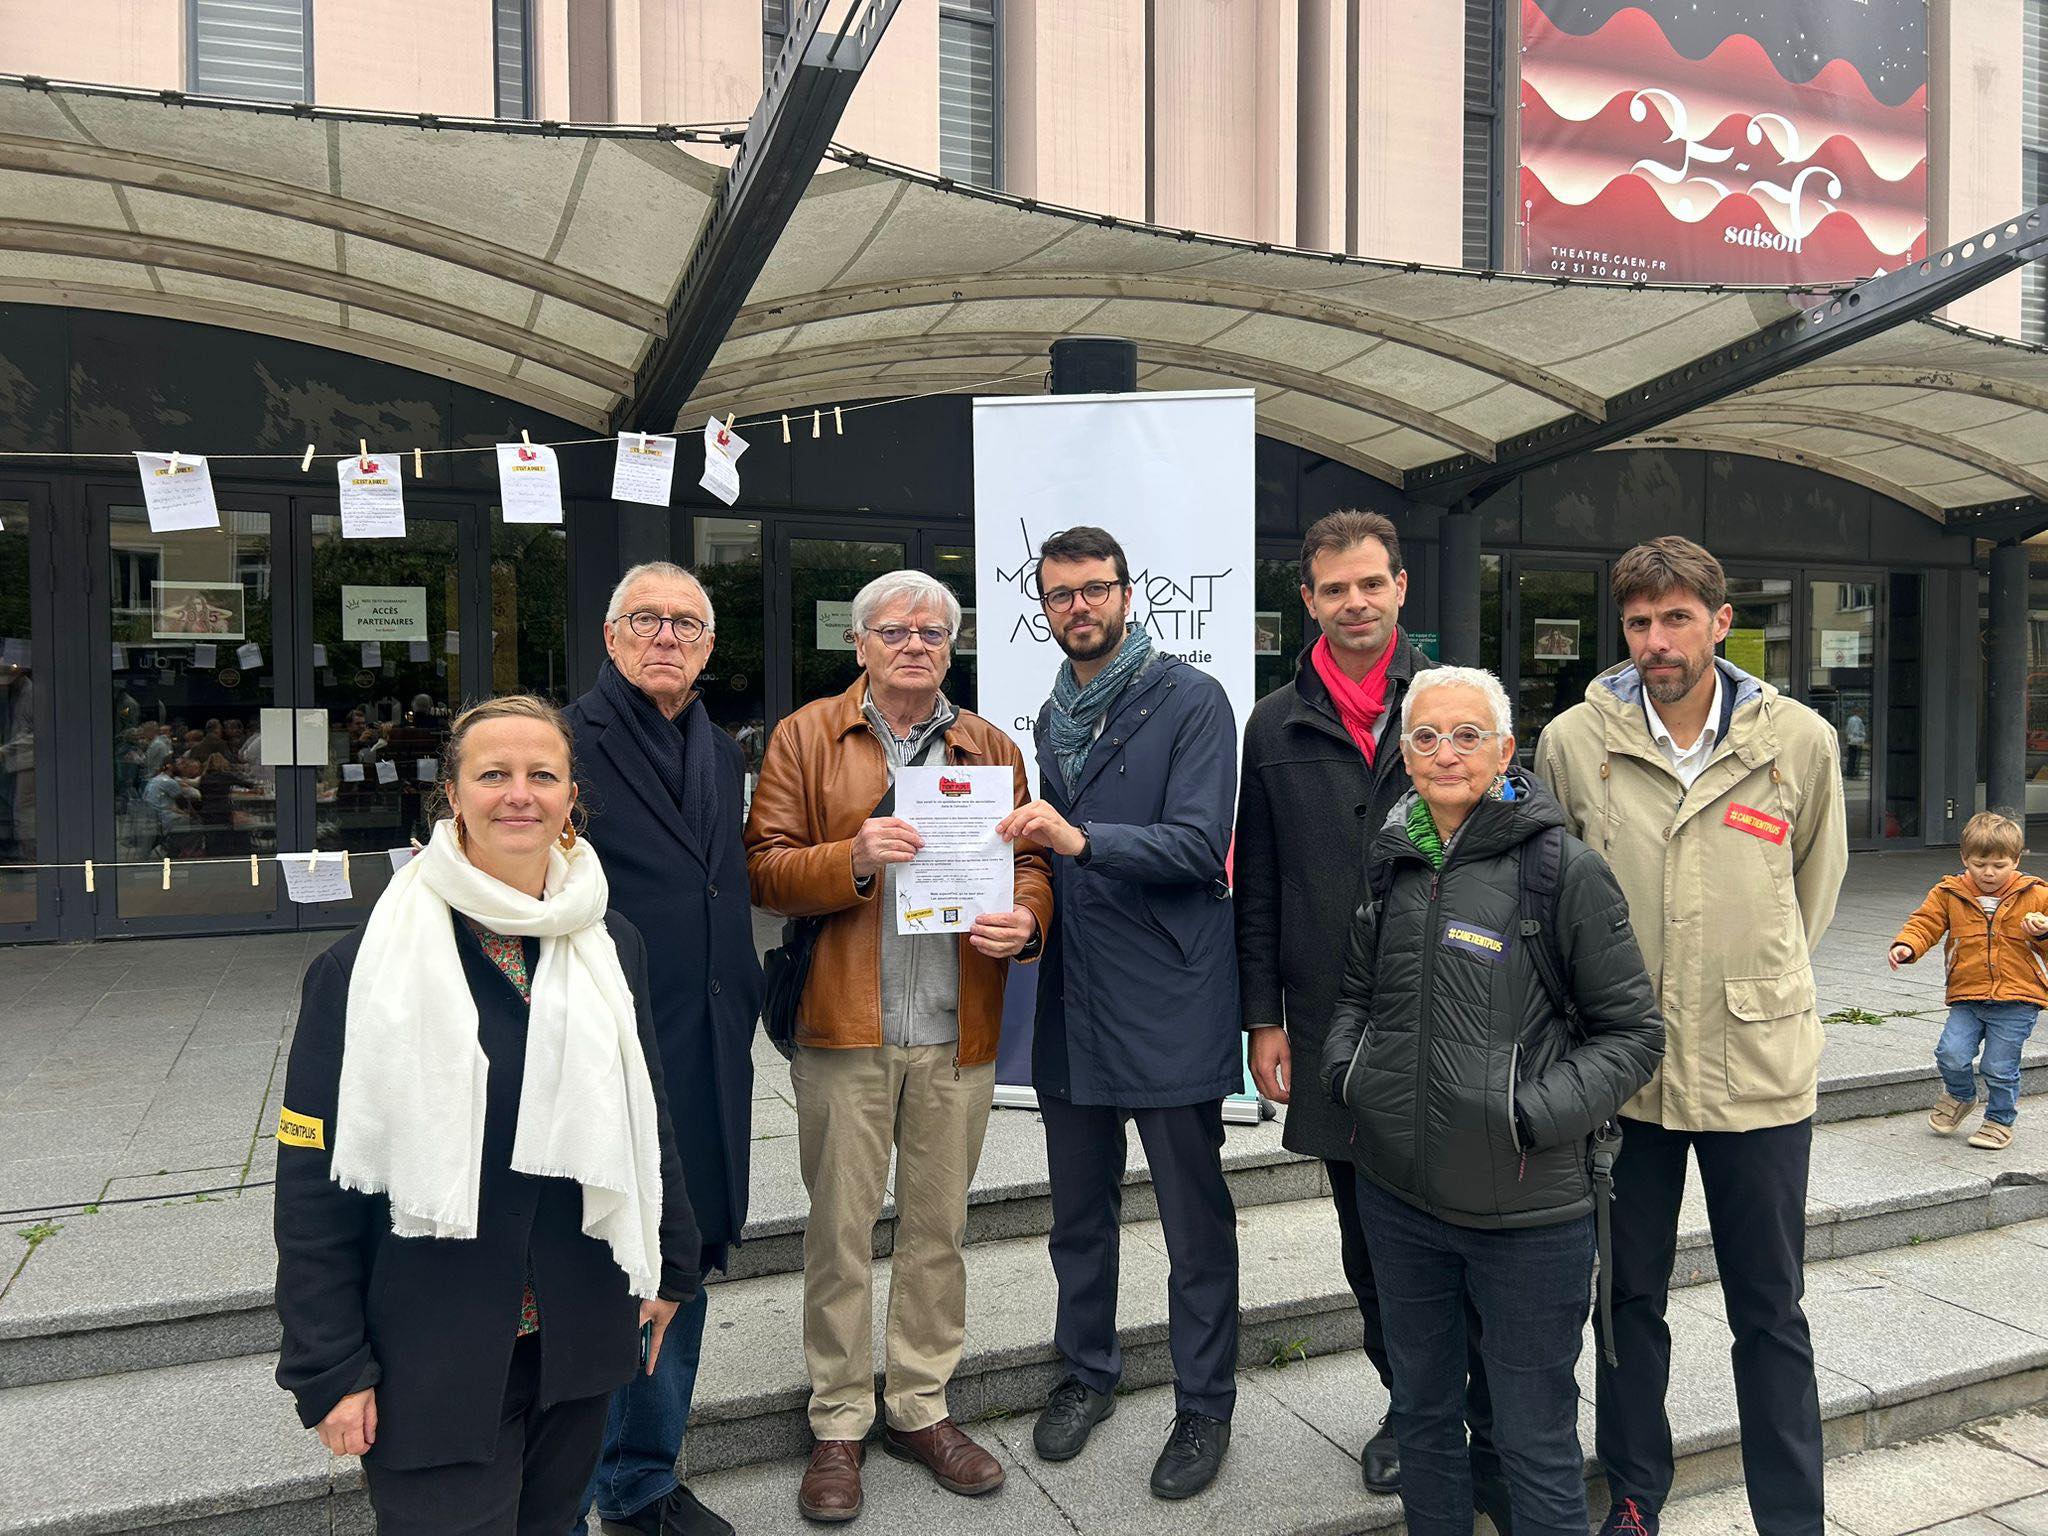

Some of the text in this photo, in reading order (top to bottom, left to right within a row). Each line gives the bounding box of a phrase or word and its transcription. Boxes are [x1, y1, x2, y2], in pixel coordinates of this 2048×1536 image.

[1723, 223, 1803, 254] saison
[1551, 246, 1666, 271] THEATRE.CAEN.FR
[1551, 261, 1648, 282] 02 31 30 48 00
[372, 606, 399, 614] ACCÈS
[1014, 716, 1035, 730] Ch
